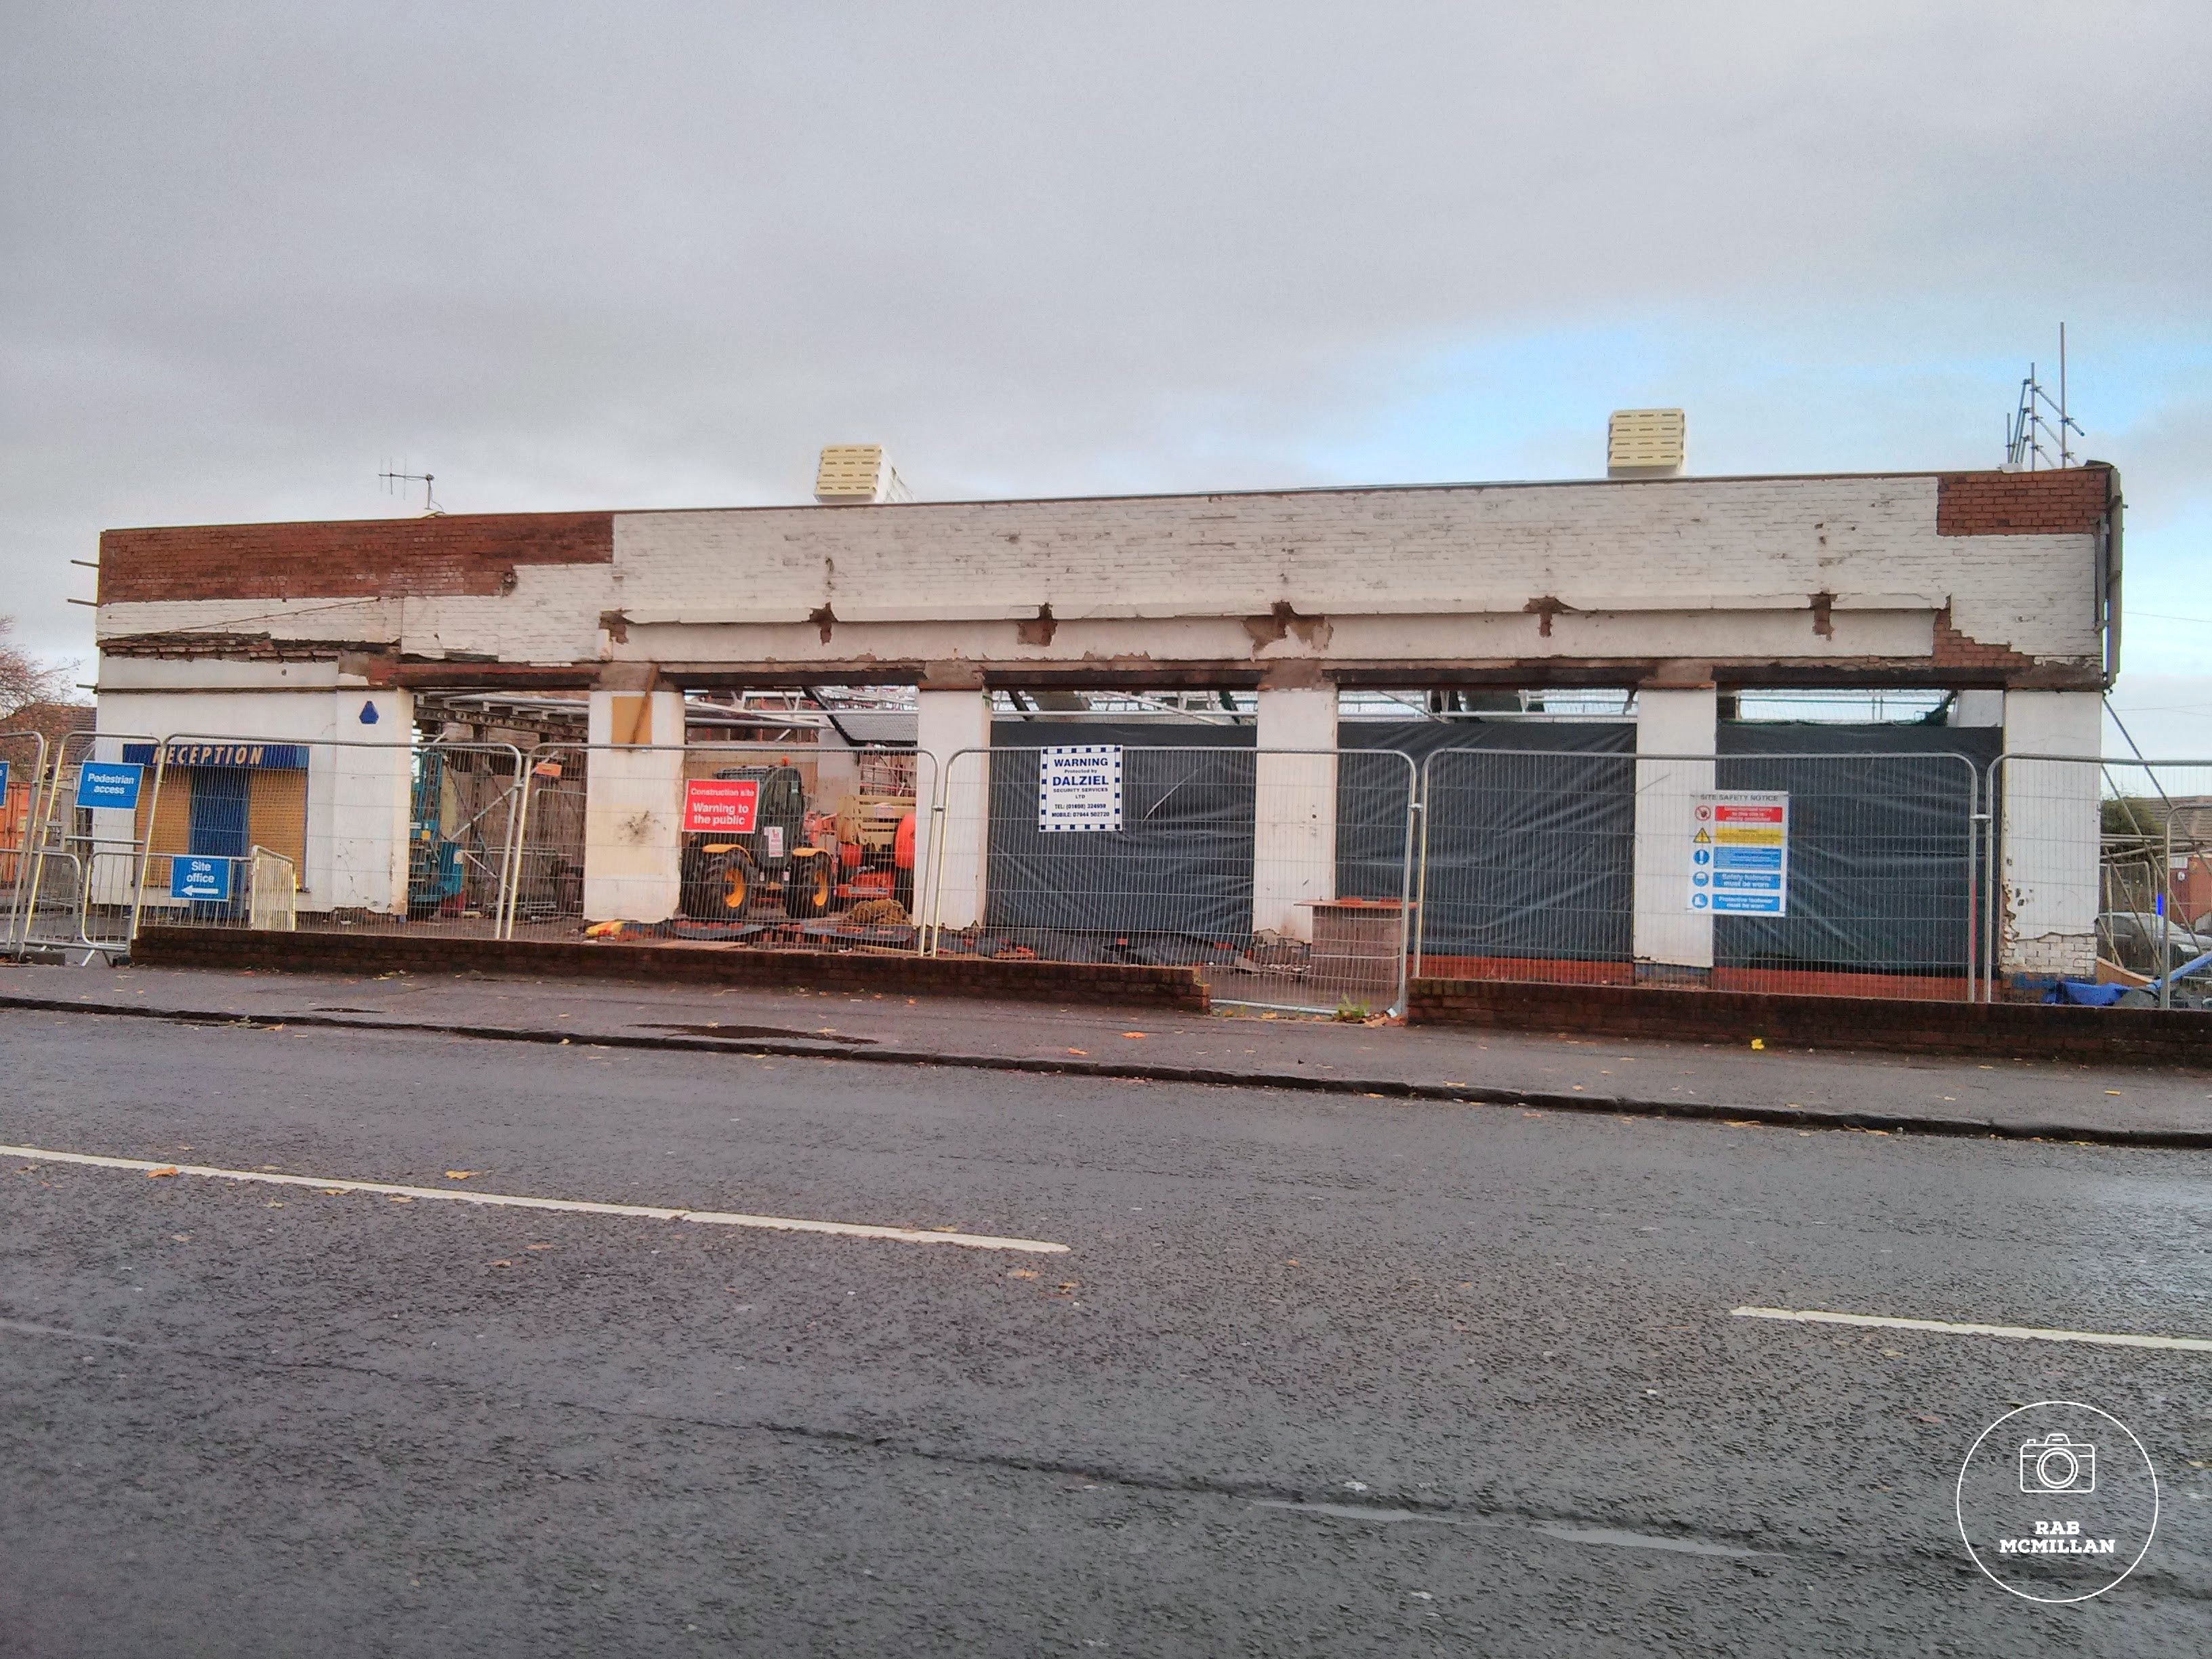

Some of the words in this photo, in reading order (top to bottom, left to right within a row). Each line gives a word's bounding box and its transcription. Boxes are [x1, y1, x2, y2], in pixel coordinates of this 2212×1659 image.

[1054, 758, 1108, 767] WARNING
[88, 773, 134, 784] Pedestrian
[1052, 776, 1109, 786] DALZIEL
[94, 785, 125, 794] access
[691, 787, 739, 796] Construction
[693, 802, 735, 814] Warning
[738, 804, 749, 813] to
[693, 813, 711, 824] the
[713, 815, 745, 826] public
[191, 861, 211, 872] Site
[186, 873, 215, 883] office
